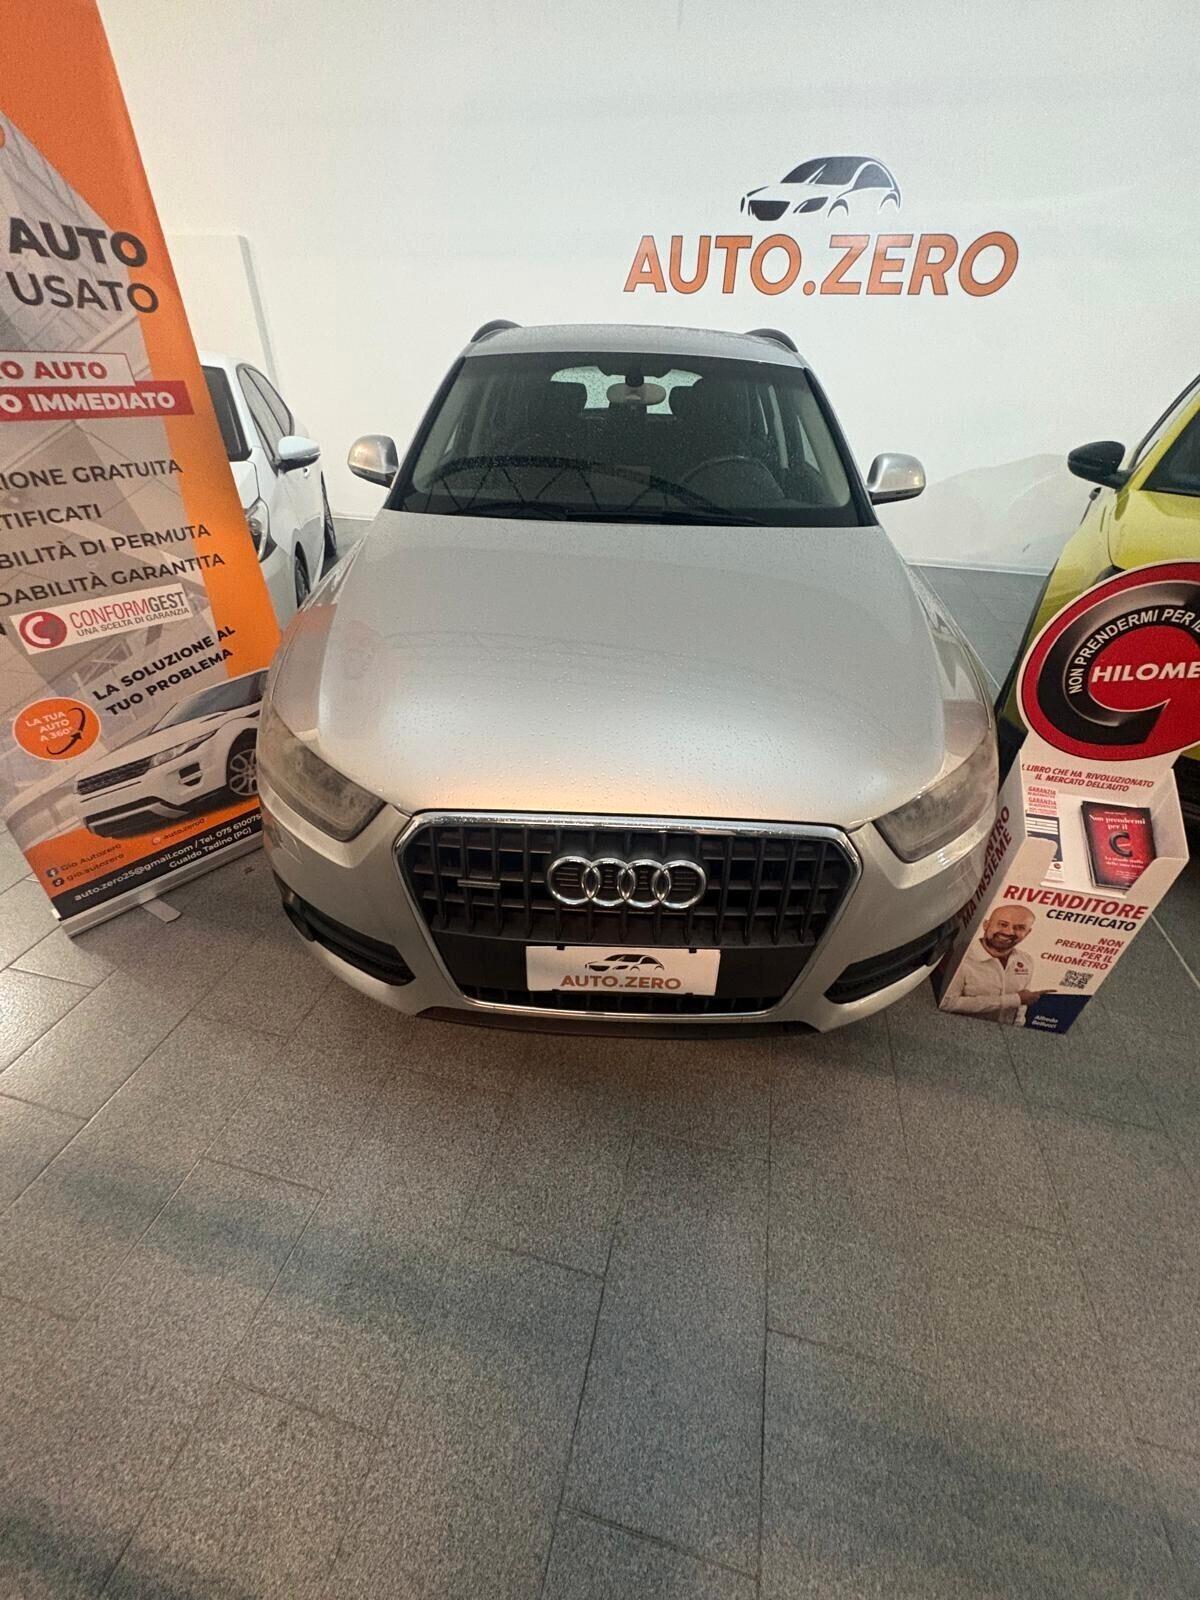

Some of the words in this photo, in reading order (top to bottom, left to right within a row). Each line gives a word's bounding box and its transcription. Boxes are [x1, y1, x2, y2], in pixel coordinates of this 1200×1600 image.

[9, 217, 148, 267] AUTO
[622, 231, 1019, 297] AUTO.ZERO
[5, 271, 159, 314] USATO
[35, 361, 108, 379] AUTO
[27, 391, 176, 412] IMMEDIATO
[0, 468, 67, 491] IONE
[72, 459, 183, 482] GRATUITA
[0, 503, 102, 531] TIFICATI
[80, 539, 107, 556] DI
[111, 524, 211, 551] PERMUTA
[112, 553, 225, 585] GARANTITA
[69, 592, 185, 629] CONFORMGEST
[76, 627, 98, 637] UNA
[100, 618, 133, 632] SCELTA
[136, 616, 145, 624] DI
[145, 608, 190, 622] GARANZIA
[92, 684, 120, 701] LA
[121, 636, 214, 687] SOLUZIONE
[217, 626, 235, 642] AL
[1068, 668, 1084, 695] NON
[1076, 609, 1159, 665] PRENDERMI
[1161, 608, 1195, 626] PER
[105, 692, 143, 715] TUO
[145, 649, 233, 696] PROBLEMA
[25, 718, 42, 727] LA
[42, 711, 67, 723] TUA
[40, 719, 70, 734] AUTO
[1026, 764, 1051, 774] LIBRO
[1052, 767, 1070, 778] CHE
[1069, 770, 1082, 779] HA
[1085, 772, 1155, 788] RIVOLUZIONATO
[1034, 773, 1043, 781] IL
[1045, 774, 1085, 786] MERCATO
[169, 850, 202, 868] Gualdo
[203, 836, 233, 853] Tadino
[234, 827, 252, 840] (PG)
[74, 845, 193, 901] auto.zero25@gmail.com
[200, 834, 215, 846] Tel.
[216, 826, 232, 837] 075
[975, 828, 1012, 902] INSIEME
[1003, 885, 1149, 920] RIVENDITORE
[1046, 909, 1137, 932] CERTIFICATO
[1055, 939, 1119, 956] PRENDERMI
[1081, 951, 1102, 962] PER
[1104, 955, 1112, 964] IL
[1098, 938, 1125, 948] NON
[1040, 952, 1108, 970] CHILOMETRO
[560, 975, 682, 990] AUTO.ZERO
